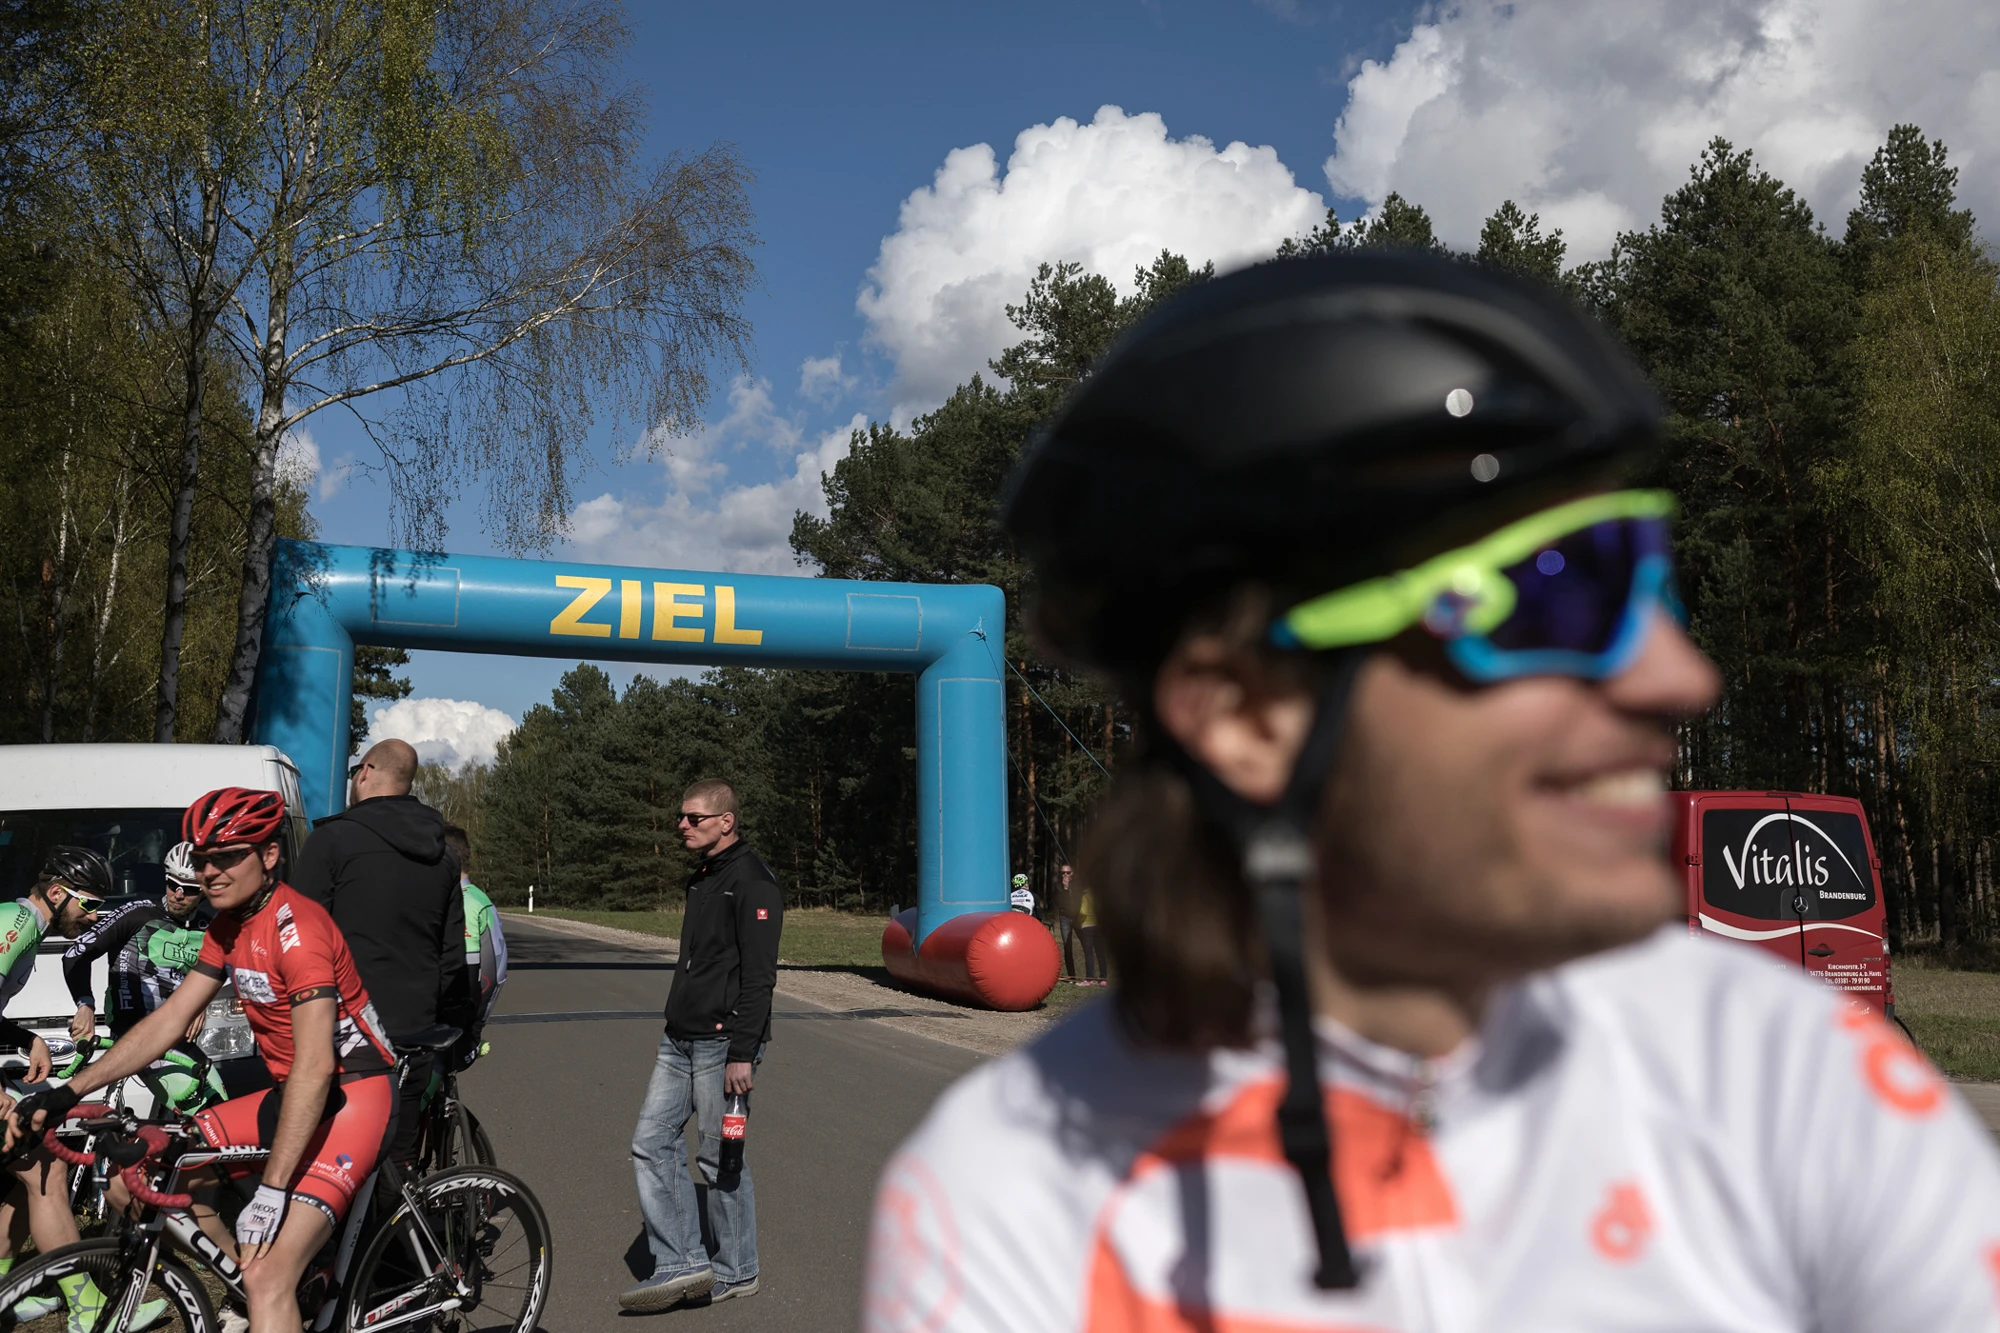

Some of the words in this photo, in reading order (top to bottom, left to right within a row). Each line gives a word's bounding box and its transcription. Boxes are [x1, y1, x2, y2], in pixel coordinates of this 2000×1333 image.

[550, 575, 763, 646] ZIEL
[1722, 835, 1832, 891] Vitalis
[1819, 889, 1867, 901] BRANDENBURG
[203, 1122, 220, 1145] PUNKT
[252, 1202, 278, 1214] GEOX
